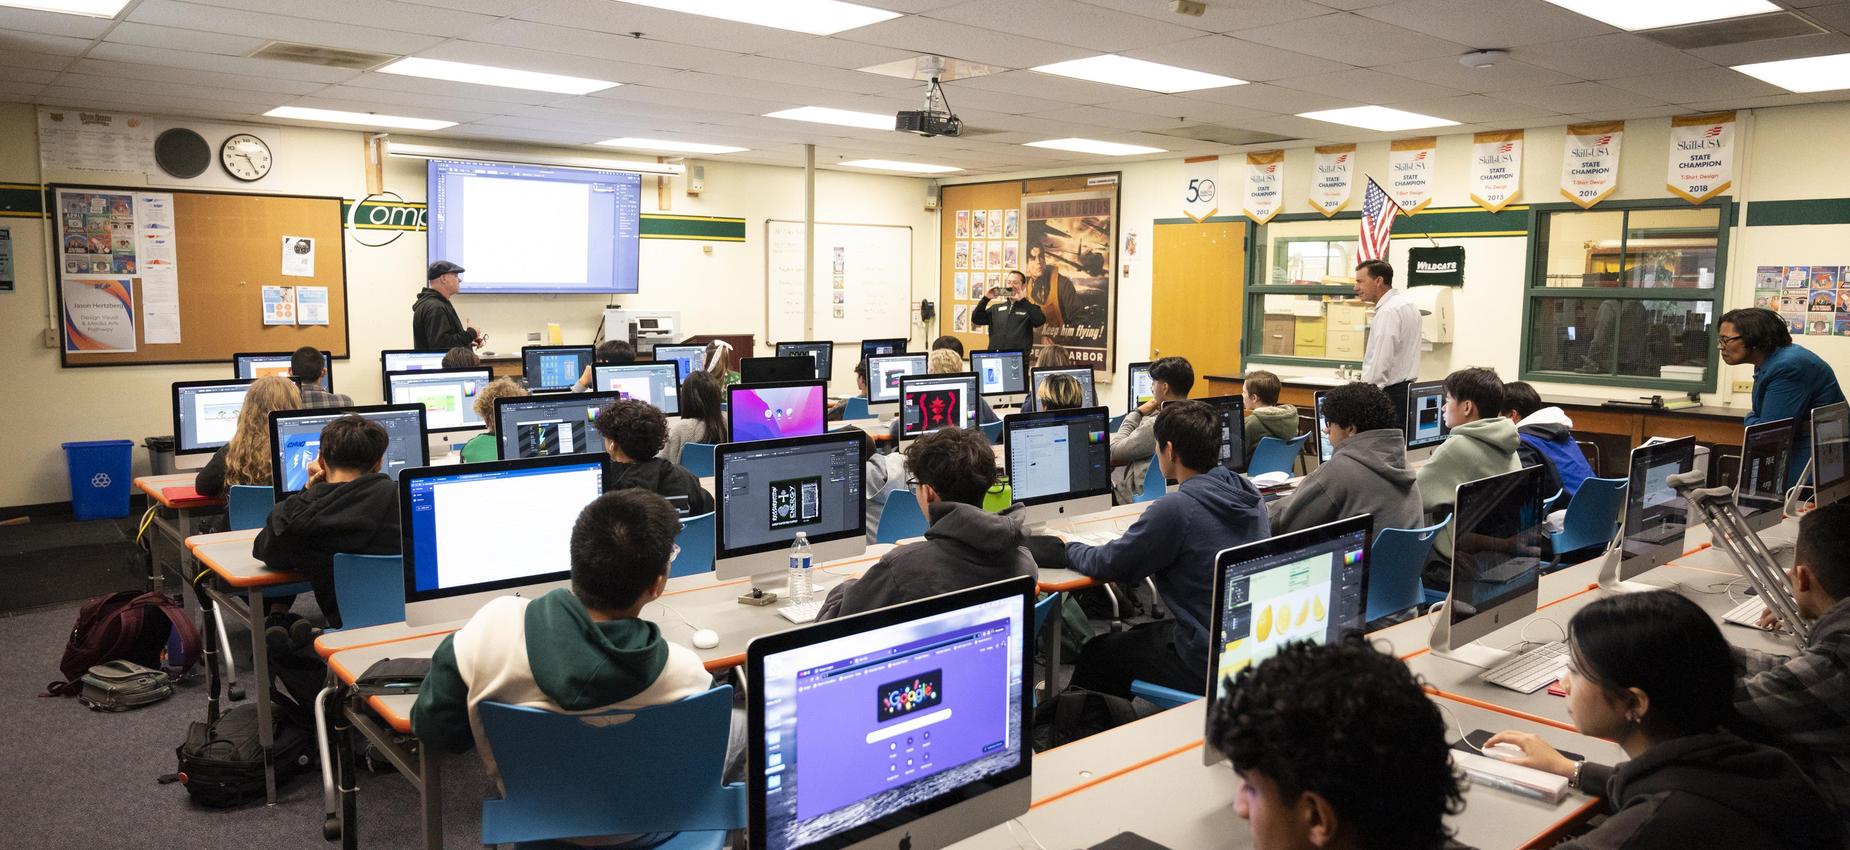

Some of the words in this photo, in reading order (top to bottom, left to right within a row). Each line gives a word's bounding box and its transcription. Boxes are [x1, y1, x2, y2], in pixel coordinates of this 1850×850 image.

[1677, 139, 1721, 150] SkillsUSA
[1571, 147, 1609, 158] SkillsUSA
[1479, 155, 1513, 164] SkillsUSA
[1679, 160, 1722, 169] CHAMPION
[1480, 173, 1514, 181] CHAMPION
[1186, 178, 1216, 203] 50
[1042, 324, 1060, 338] Keep
[1060, 324, 1075, 337] him
[1075, 325, 1104, 340] flying!
[890, 682, 932, 706] Google
